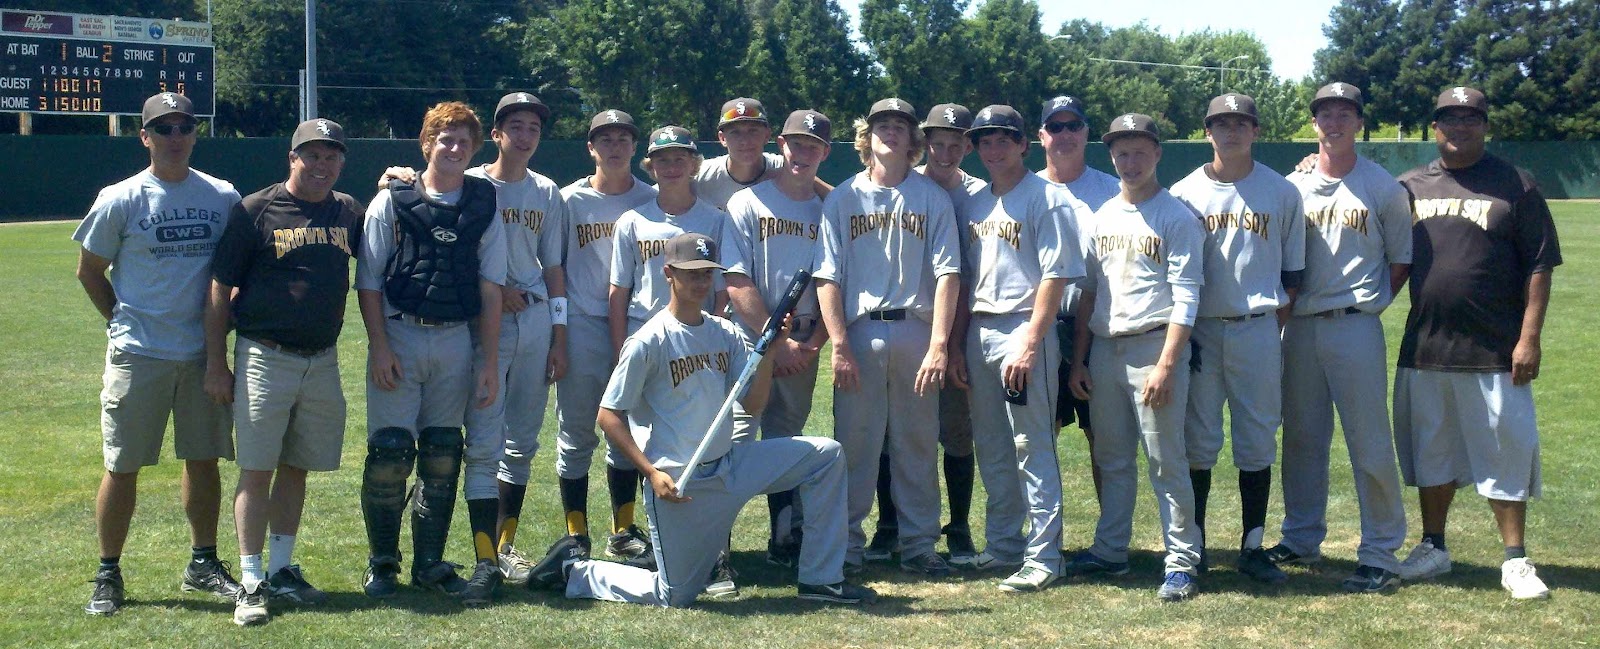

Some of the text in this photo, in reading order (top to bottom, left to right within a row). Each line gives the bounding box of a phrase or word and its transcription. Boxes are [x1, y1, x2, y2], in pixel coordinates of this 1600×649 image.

[7, 43, 39, 56] AT BAT
[76, 46, 98, 59] BALL
[123, 49, 155, 61] STRIKE
[178, 52, 196, 63] OUT
[0, 77, 32, 89] GUEST
[40, 65, 202, 81] 1 2 3 4 5 6 7 8 9 10 R H E
[1, 96, 29, 109] HOME
[138, 207, 222, 231] COLLEGE
[523, 209, 545, 236] SOX
[850, 211, 927, 241] BROWN SOX
[1243, 212, 1270, 241] SOX
[1342, 208, 1369, 237] SOX
[1461, 198, 1493, 231] SOX
[163, 226, 206, 239] CWS
[576, 222, 617, 250] BROW
[758, 216, 805, 242] BROWN
[998, 220, 1022, 251] SOX
[149, 244, 185, 255] WORLD
[273, 227, 328, 260] BROWN
[1137, 235, 1162, 265] SOX
[669, 352, 712, 390] BROWN
